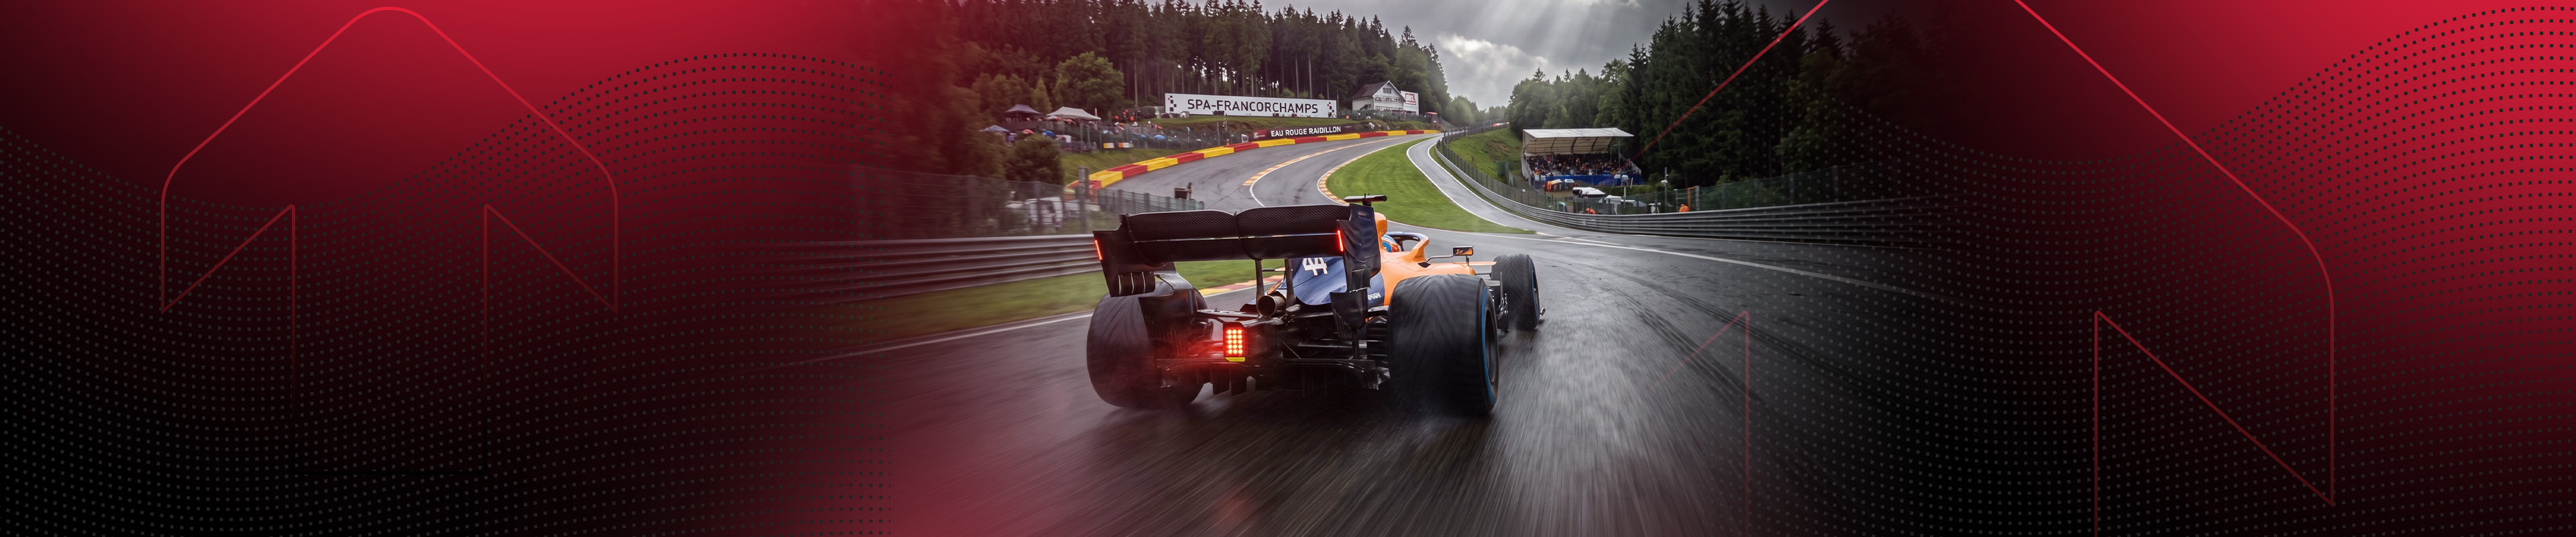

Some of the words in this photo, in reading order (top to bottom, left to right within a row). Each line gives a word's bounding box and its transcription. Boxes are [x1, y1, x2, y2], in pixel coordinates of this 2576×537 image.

[1187, 99, 1318, 113] SPA-FRANCORCHAMPS
[1285, 128, 1307, 136] ROUGE
[1309, 126, 1341, 134] RAIDILLON
[1302, 257, 1328, 276] 44
